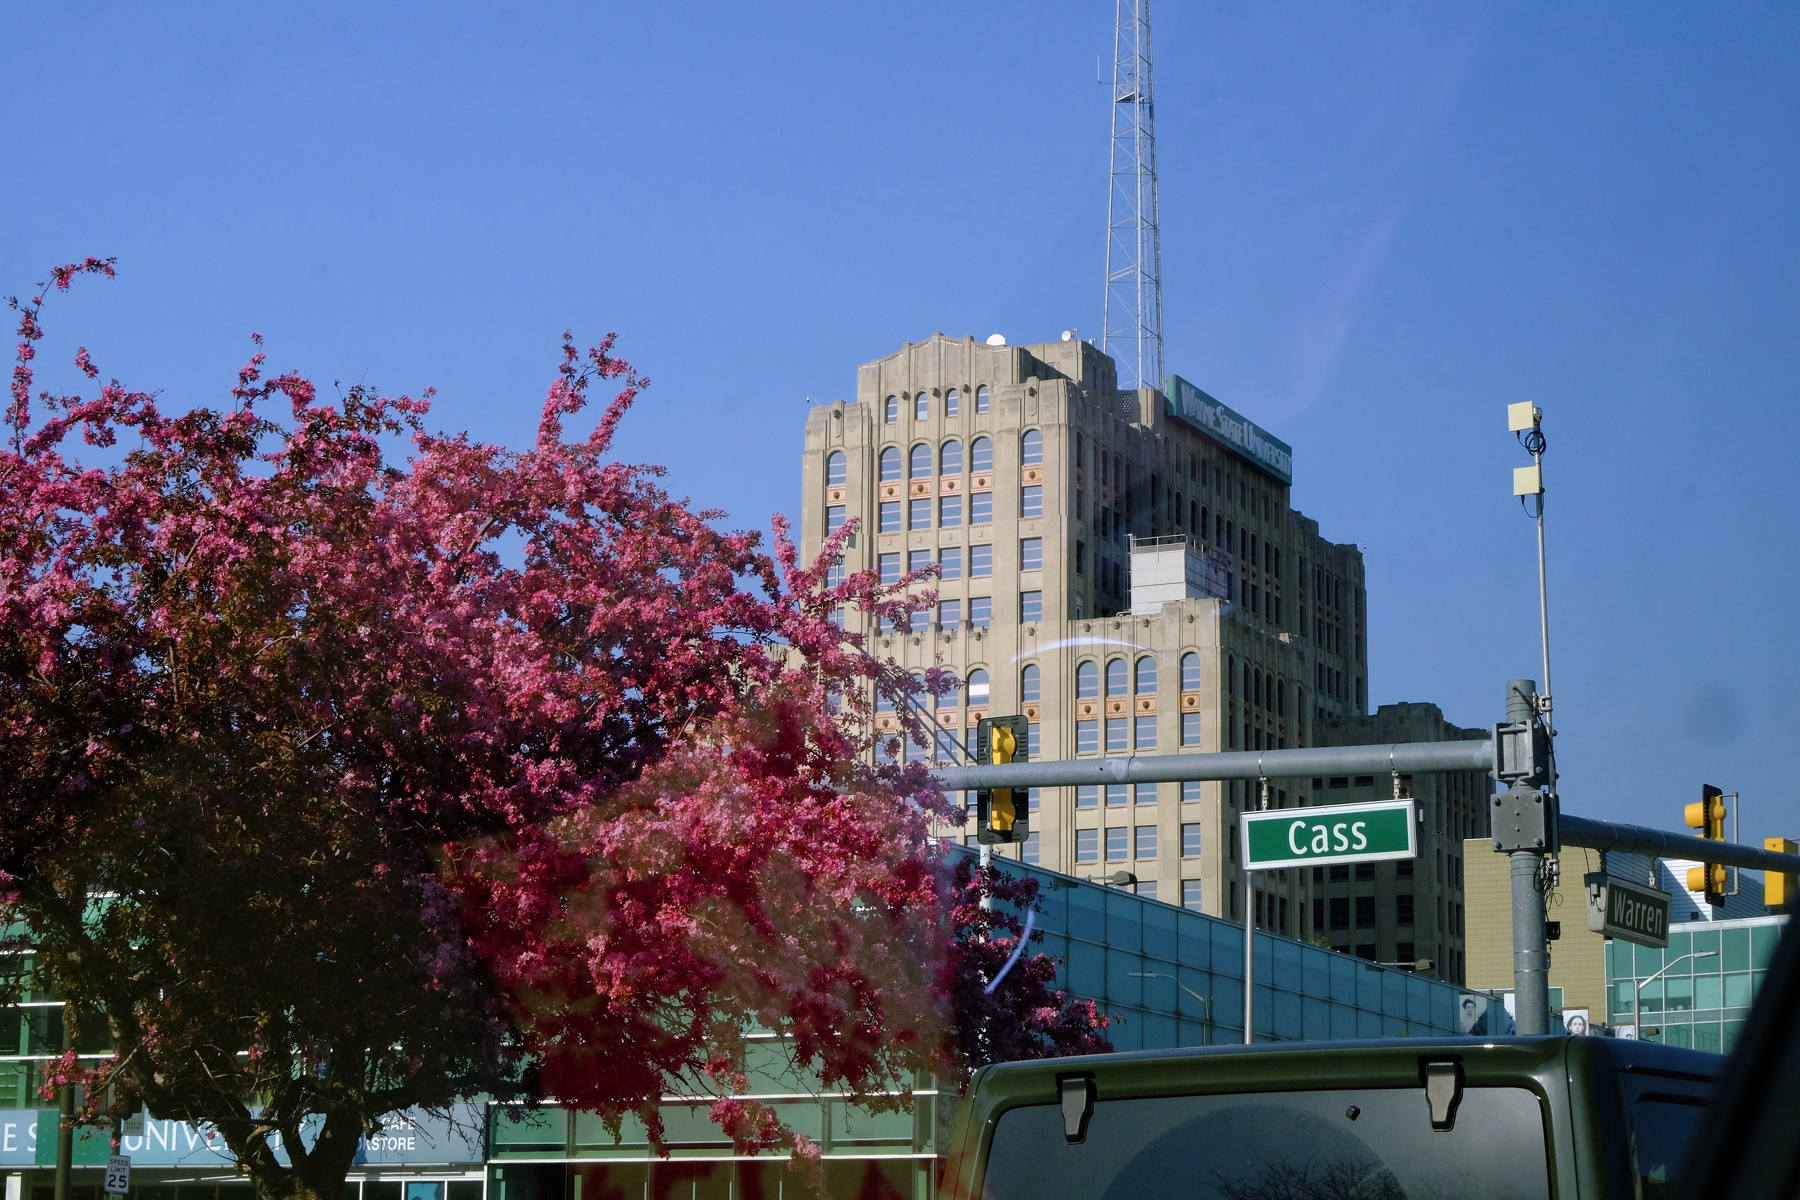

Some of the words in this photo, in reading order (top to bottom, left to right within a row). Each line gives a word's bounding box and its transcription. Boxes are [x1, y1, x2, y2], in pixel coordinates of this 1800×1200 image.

[1180, 383, 1217, 430] WAYNE
[1214, 405, 1245, 447] STATE
[1243, 421, 1292, 476] UNIVERSITY
[1288, 820, 1368, 855] Cass
[1614, 889, 1663, 935] Warren
[110, 1158, 129, 1167] SPEED
[110, 1166, 127, 1174] LIMIT
[108, 1173, 127, 1188] 25
